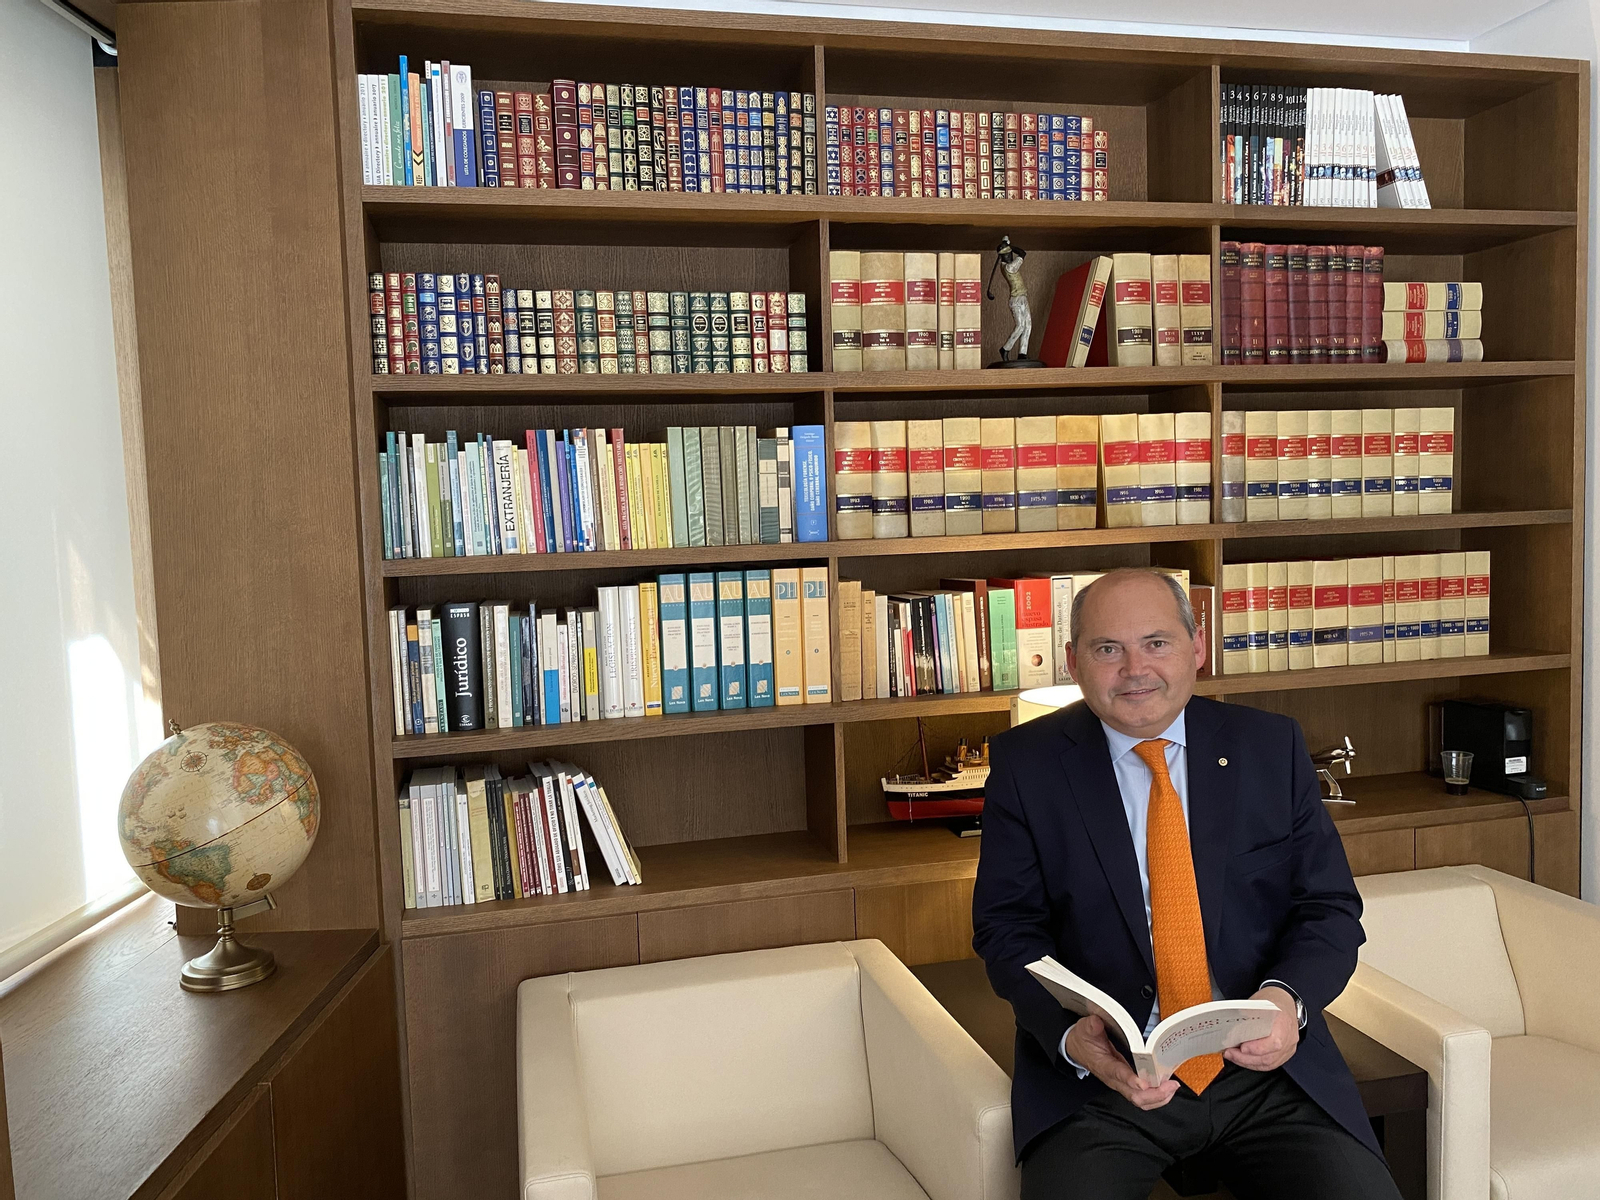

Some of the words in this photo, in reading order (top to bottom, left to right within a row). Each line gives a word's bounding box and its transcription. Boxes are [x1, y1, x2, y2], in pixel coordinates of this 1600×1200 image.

[1222, 92, 1226, 100] 1
[1230, 91, 1235, 99] 3
[1237, 92, 1242, 101] 4
[1245, 93, 1250, 102] 5
[1254, 92, 1259, 100] 6
[1262, 93, 1267, 101] 7
[1270, 93, 1275, 102] 8
[1278, 94, 1283, 102] 9
[1286, 96, 1292, 104] 10
[1292, 96, 1299, 104] 11
[497, 454, 515, 532] EXTRANJERÍA
[663, 585, 683, 602] AU
[692, 584, 712, 600] AU
[721, 582, 741, 599] AU
[749, 580, 769, 598] AU
[775, 582, 797, 599] PH
[804, 581, 826, 598] PH
[455, 637, 472, 697] Jurídico
[589, 804, 598, 822] Marketing
